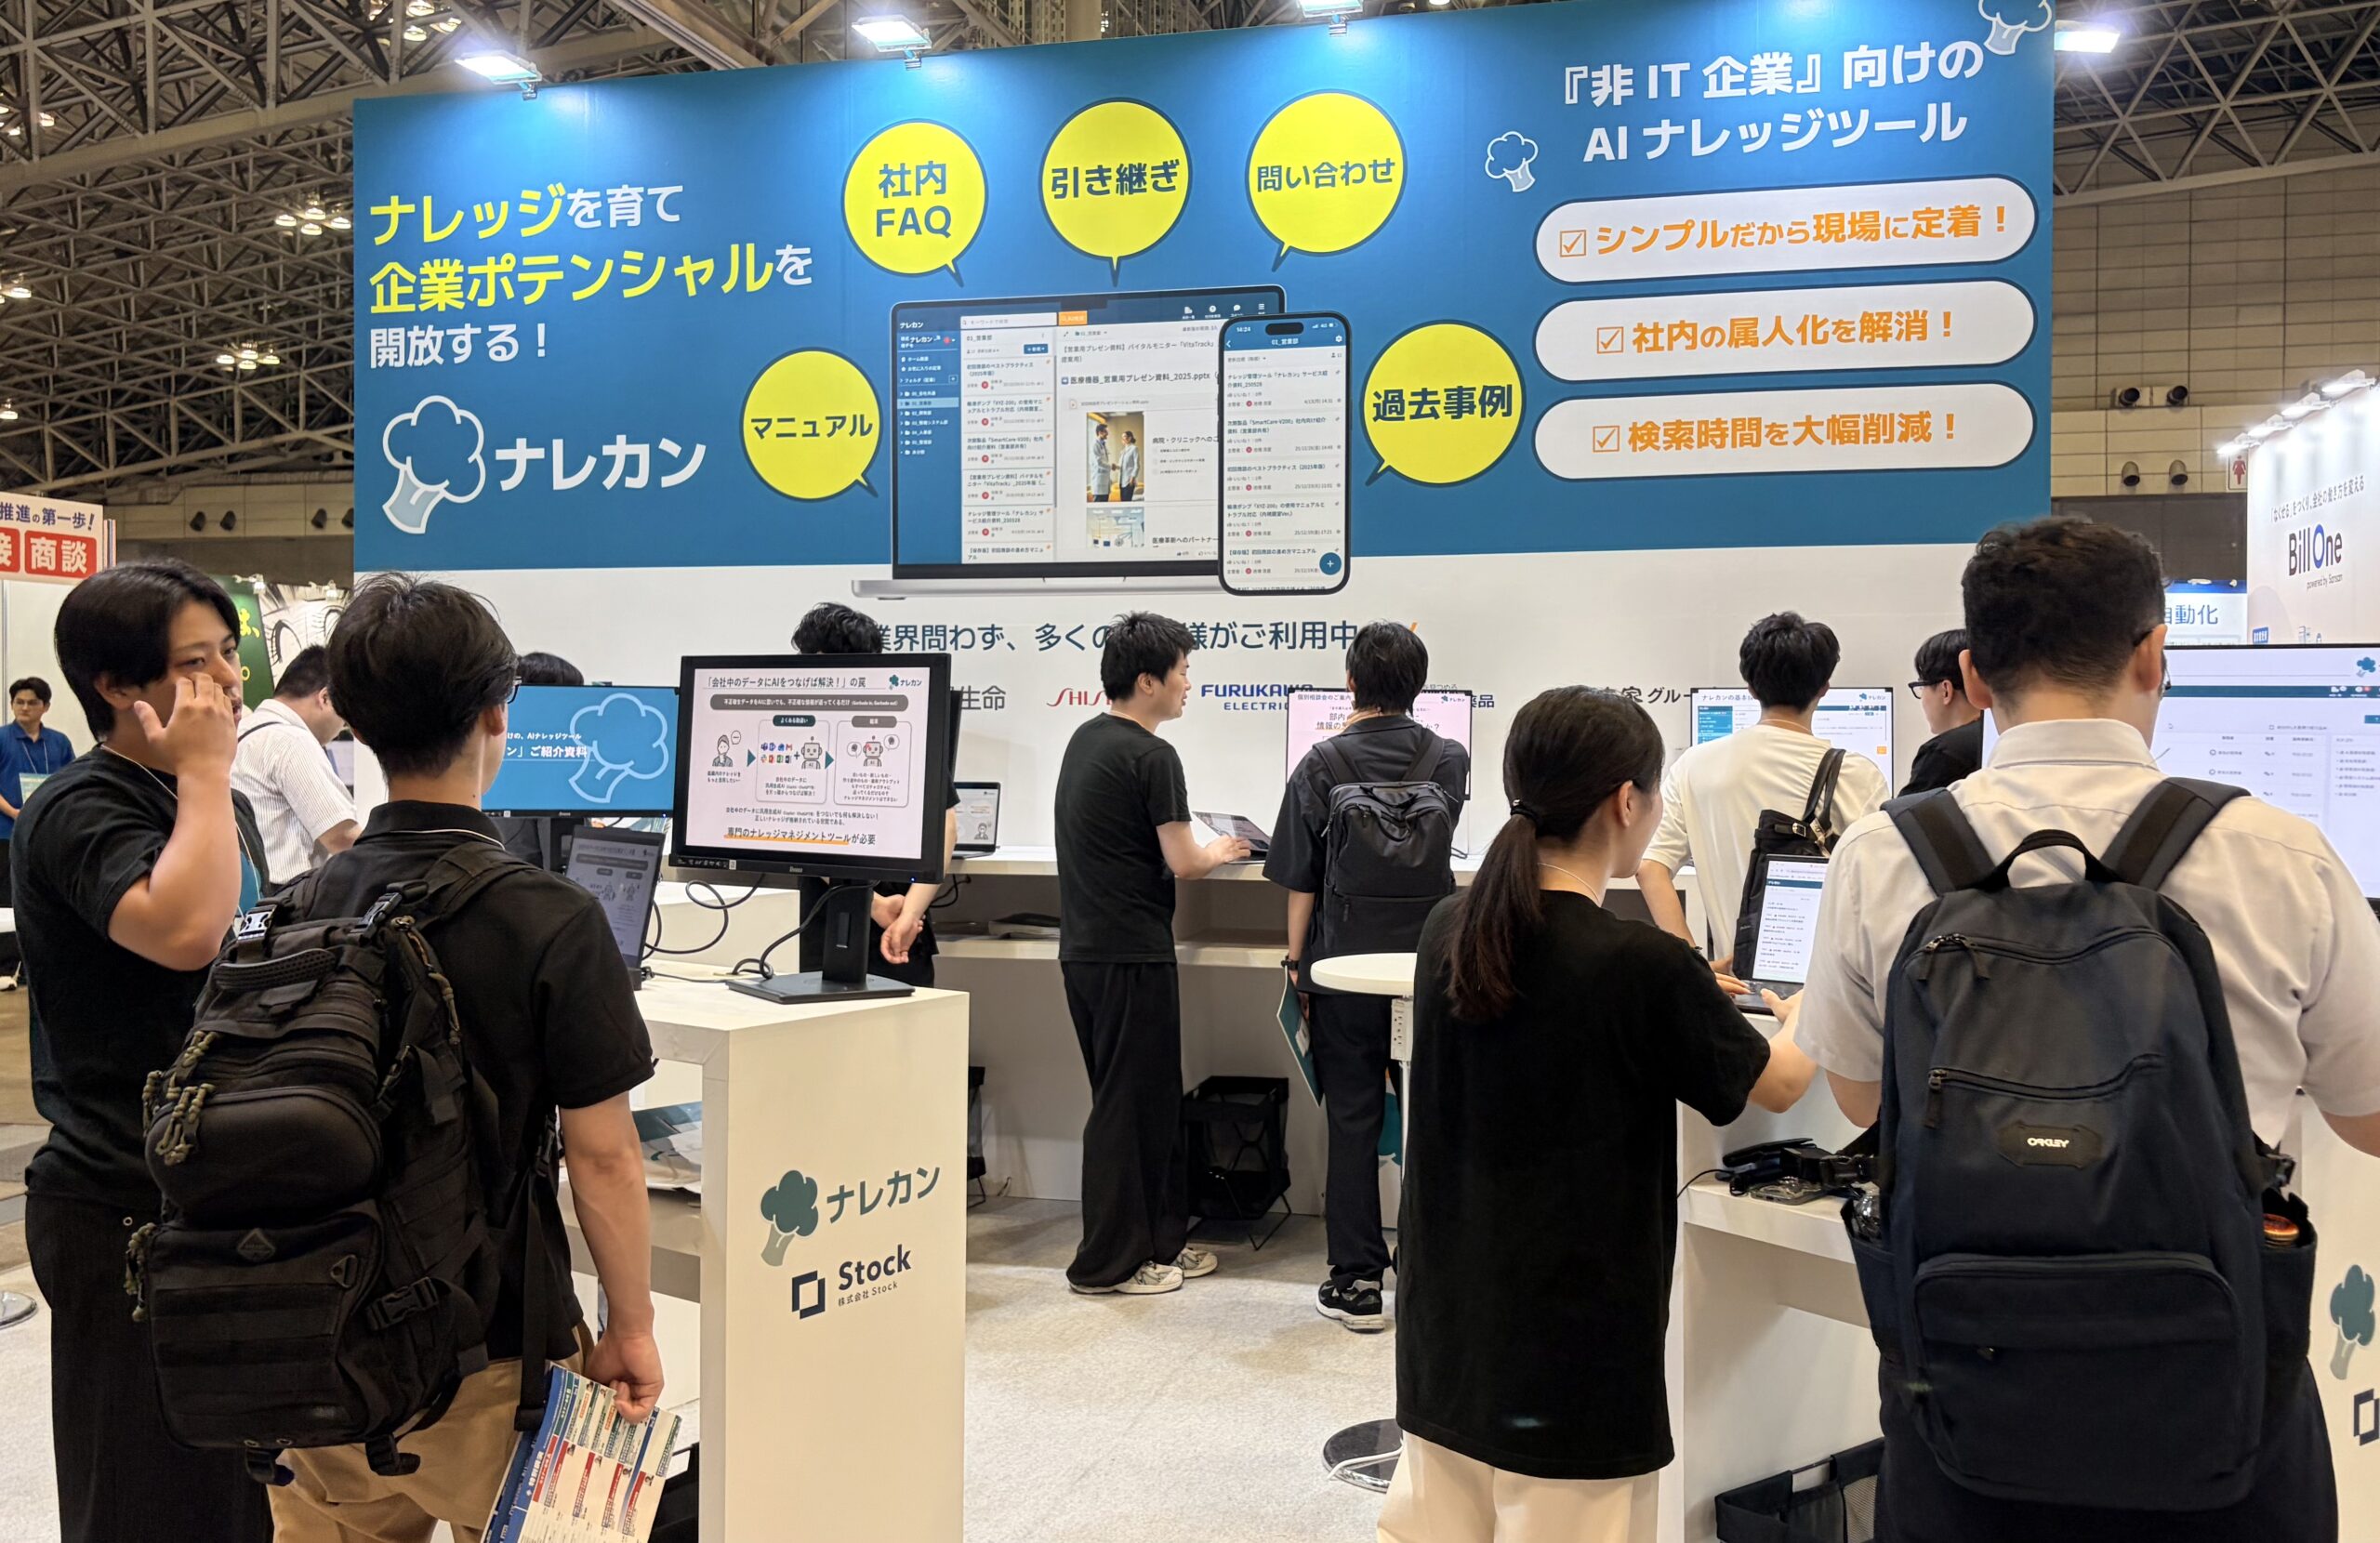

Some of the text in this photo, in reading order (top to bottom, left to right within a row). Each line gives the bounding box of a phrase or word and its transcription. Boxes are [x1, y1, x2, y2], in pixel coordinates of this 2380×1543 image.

[1643, 102, 1967, 160] ナレッジツール
[878, 161, 948, 198] 社内
[1051, 159, 1181, 200] 引き継ぎ
[1256, 158, 1395, 192] 問い合わせ
[369, 182, 684, 246] ナレッジを育て
[875, 206, 952, 239] FAQ
[1596, 204, 2006, 256] シンプルだから現場に定着！
[369, 243, 813, 314] 企業ポテンシャルを
[370, 323, 548, 370] 開放する！
[1632, 310, 1952, 354] 社内の属人化を解消！
[1372, 384, 1513, 423] 過去事例
[750, 411, 874, 441] マニュアル
[1627, 411, 1955, 453] 検索時間を大幅削減！
[494, 434, 707, 493] ナレカン
[0, 502, 95, 531] 推進の第一歩！
[30, 536, 87, 574] 商談
[900, 679, 922, 687] ナレカン
[951, 685, 1007, 710] 生命
[826, 1167, 940, 1224] ナレカン
[839, 1244, 911, 1290] Stock
[838, 1281, 898, 1307] 株式会社 Stock
